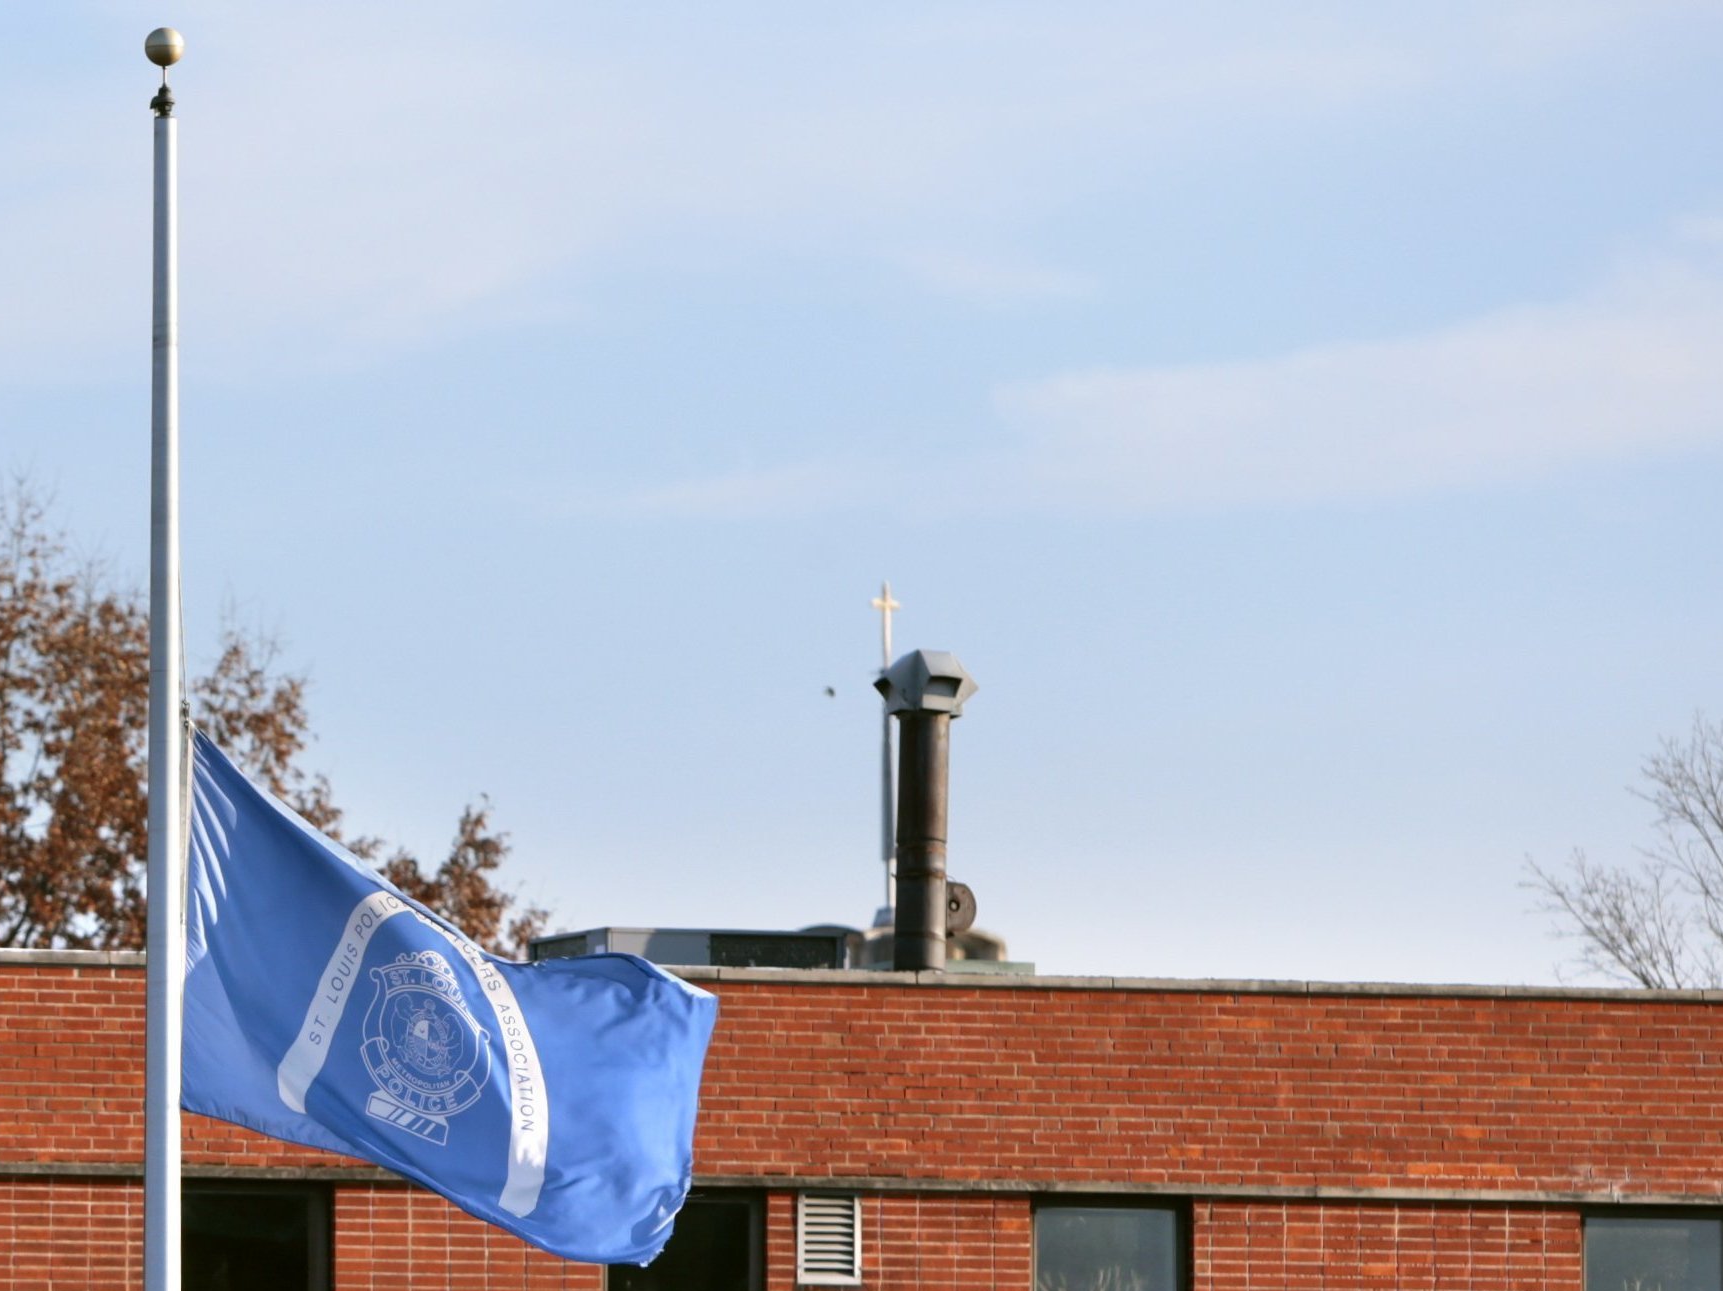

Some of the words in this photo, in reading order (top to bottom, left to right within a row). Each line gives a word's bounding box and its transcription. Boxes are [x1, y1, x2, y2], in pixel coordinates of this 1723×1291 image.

[326, 943, 358, 1004] LOUIS
[354, 896, 401, 940] POLIC
[497, 1003, 534, 1132] ASSOCIATION
[375, 1064, 458, 1112] POLICE
[391, 1057, 451, 1090] METROPOLITAN
